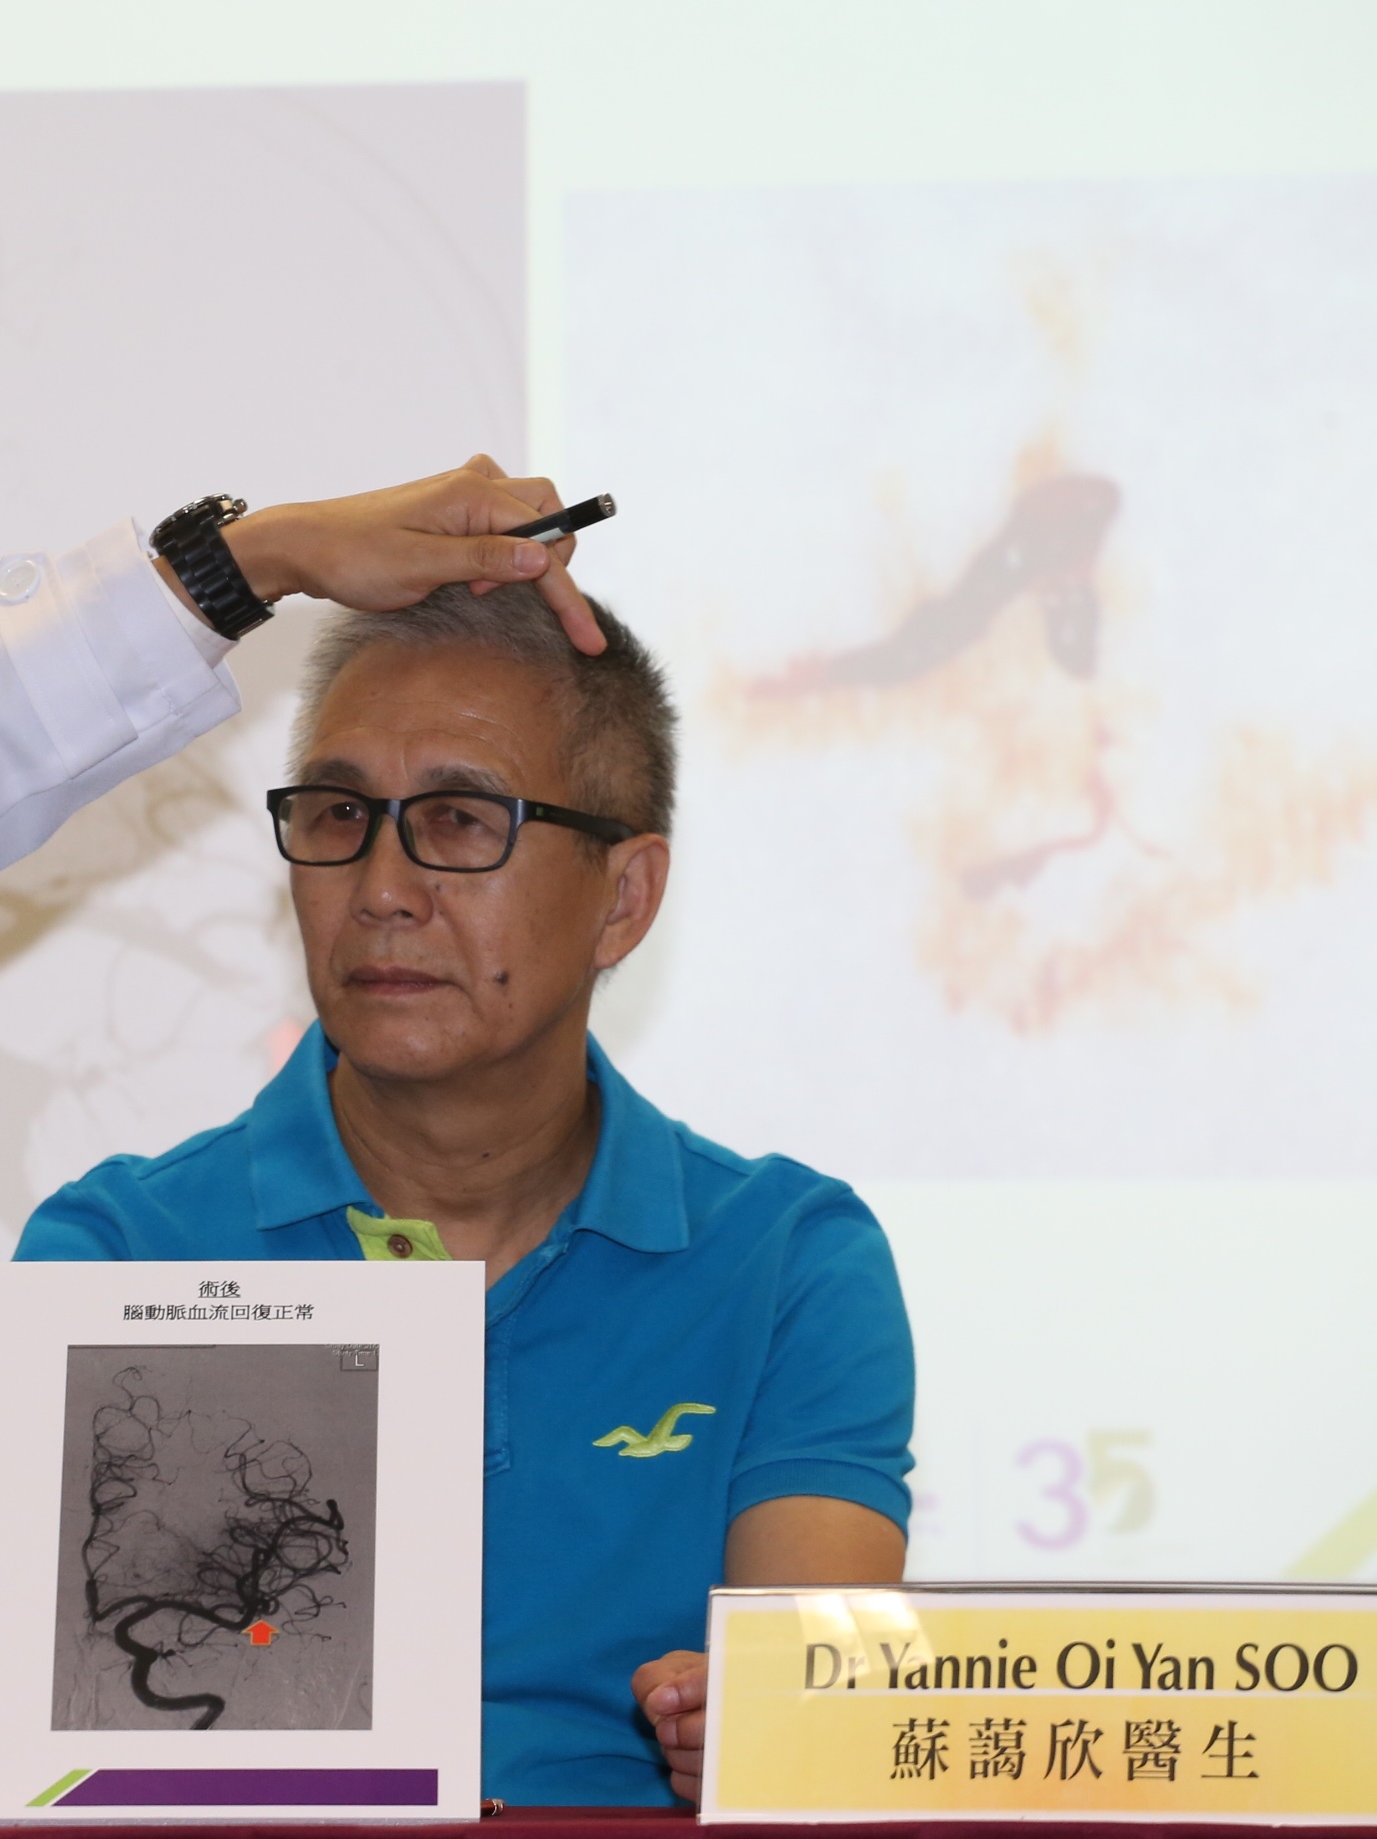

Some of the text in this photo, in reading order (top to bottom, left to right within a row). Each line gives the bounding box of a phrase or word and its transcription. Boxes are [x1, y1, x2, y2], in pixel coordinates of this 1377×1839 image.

[123, 1304, 315, 1321] 腦動脈血流回復正常
[198, 1280, 241, 1298] 術後
[1015, 1428, 1159, 1552] 35
[803, 1638, 1359, 1691] Dr Yannie Oi Yan SOO
[890, 1717, 1259, 1782] 蘇藹欣醫生
